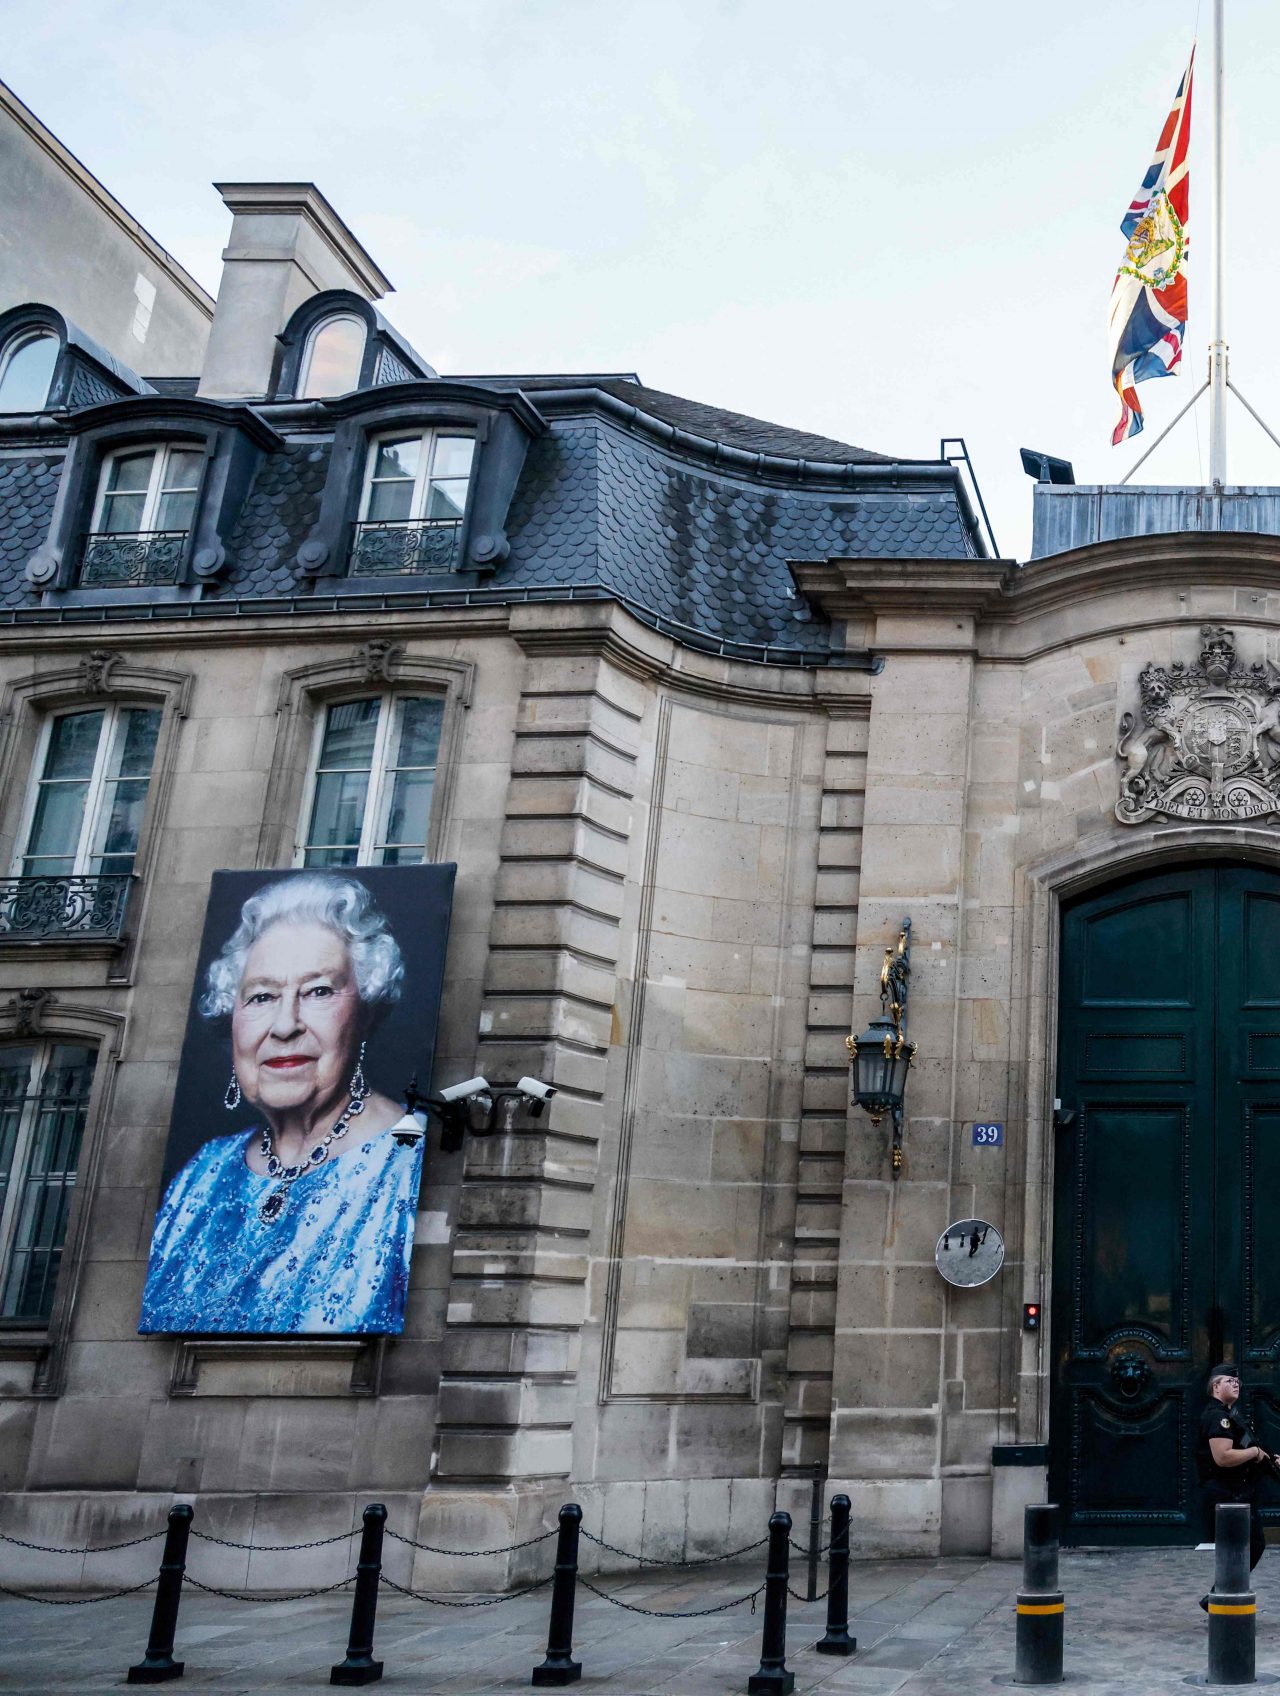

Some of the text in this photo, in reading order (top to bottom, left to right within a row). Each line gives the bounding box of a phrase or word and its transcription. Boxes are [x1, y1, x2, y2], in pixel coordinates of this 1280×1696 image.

[1153, 799, 1279, 820] DIEU ET MON DROIT
[977, 1126, 998, 1143] 39
